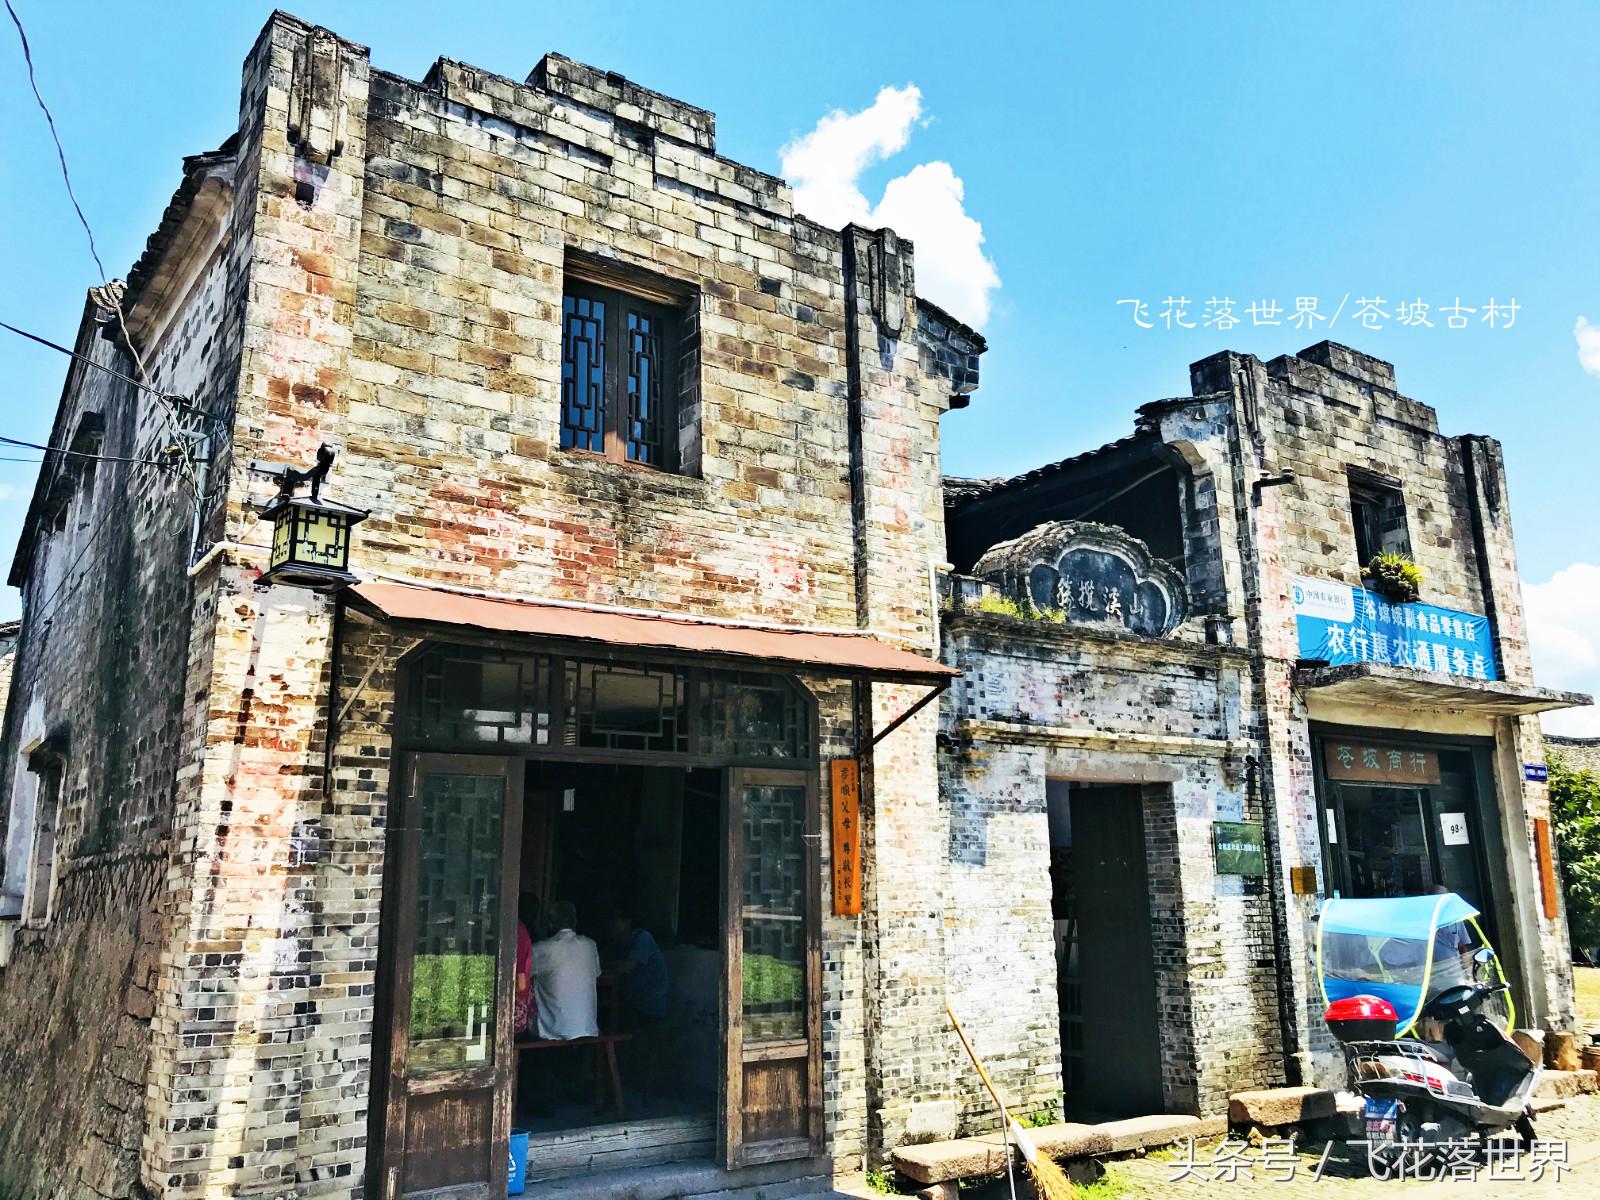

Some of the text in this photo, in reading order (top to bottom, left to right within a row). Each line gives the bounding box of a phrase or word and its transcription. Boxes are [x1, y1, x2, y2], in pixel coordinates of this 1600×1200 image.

[1327, 623, 1487, 680] 农行惠农通服务点
